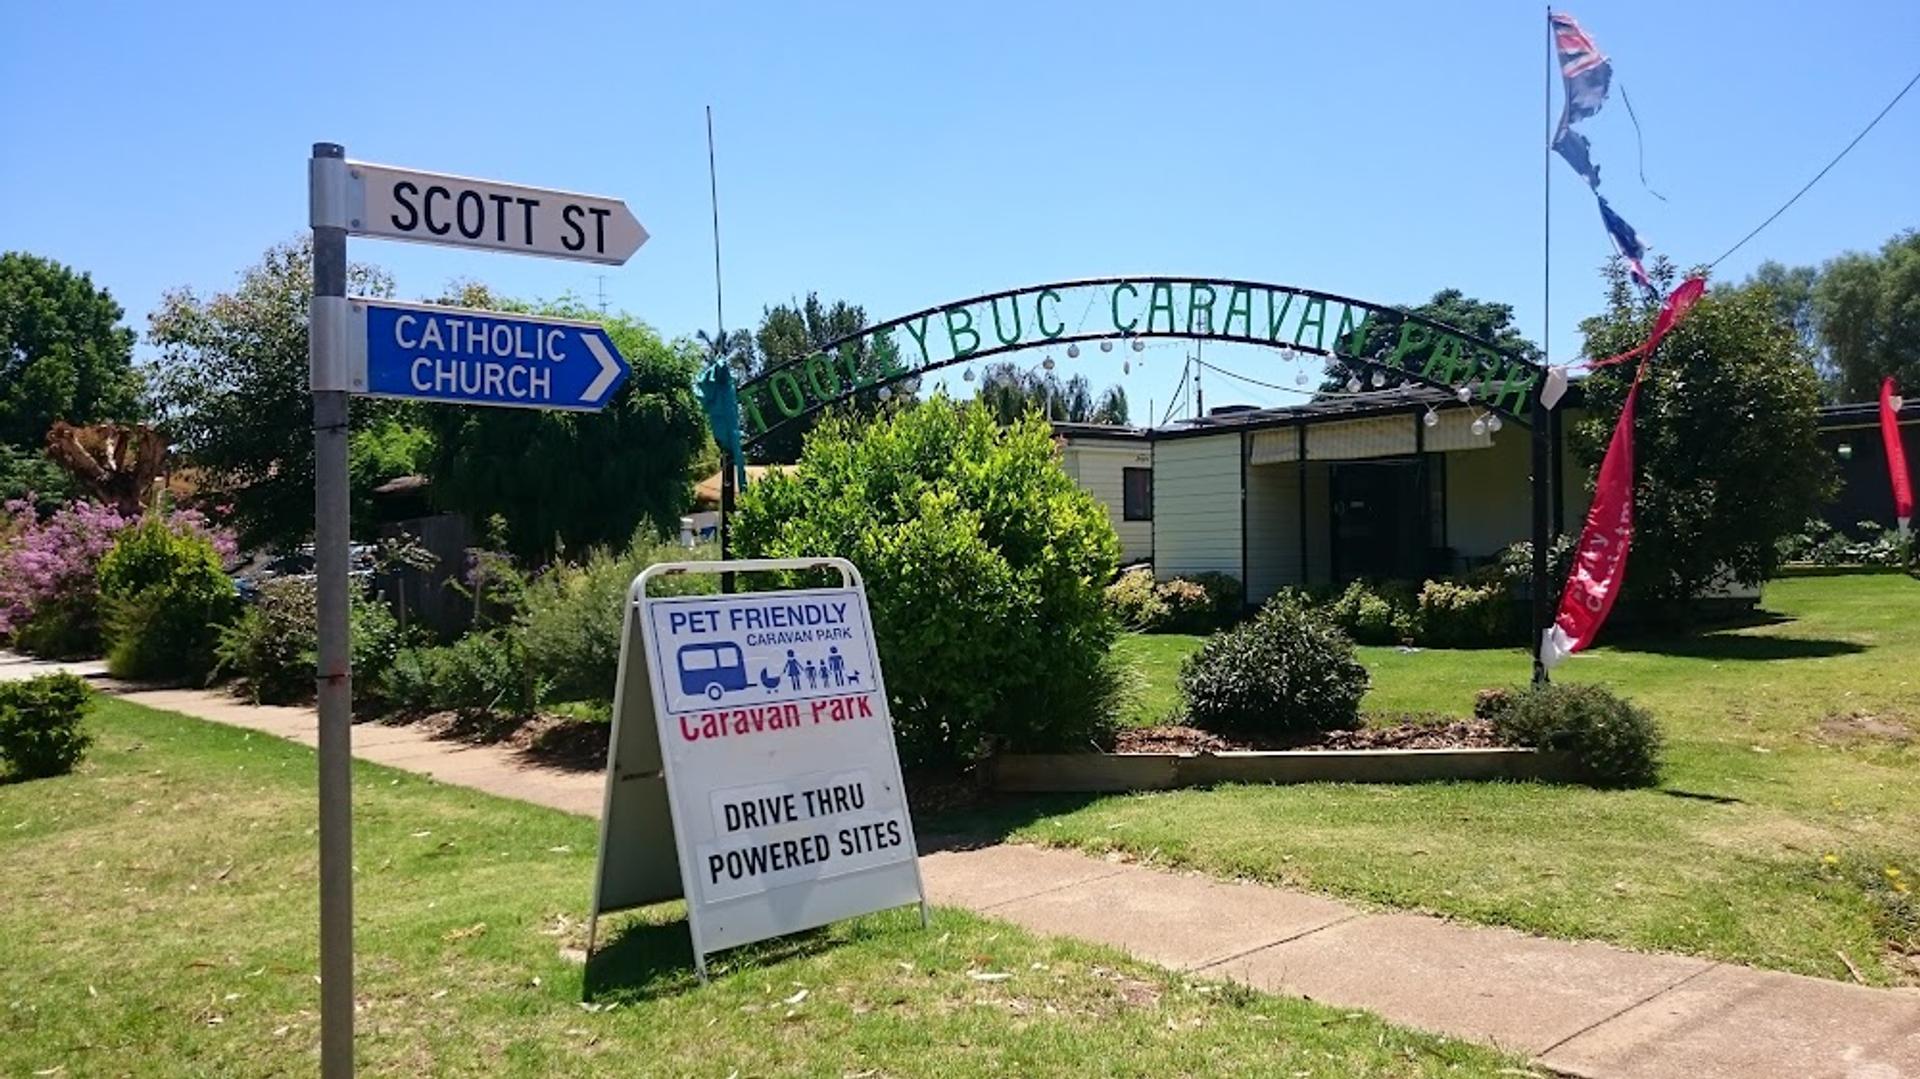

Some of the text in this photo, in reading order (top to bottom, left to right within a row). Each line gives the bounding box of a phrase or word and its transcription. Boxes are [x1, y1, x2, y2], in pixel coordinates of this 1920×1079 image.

[391, 181, 612, 254] SCOTT ST
[395, 315, 566, 362] CATHOLIC
[737, 281, 1540, 434] TOOLEYBUC CARAVAN PARK
[410, 357, 551, 399] CHURCH
[670, 603, 847, 634] PET FRIENDLY
[746, 627, 853, 647] CARAVAN PARK
[681, 695, 873, 741] Caravan Park
[724, 783, 865, 832] DRIVE THRU
[708, 820, 901, 884] POWERED SITES
